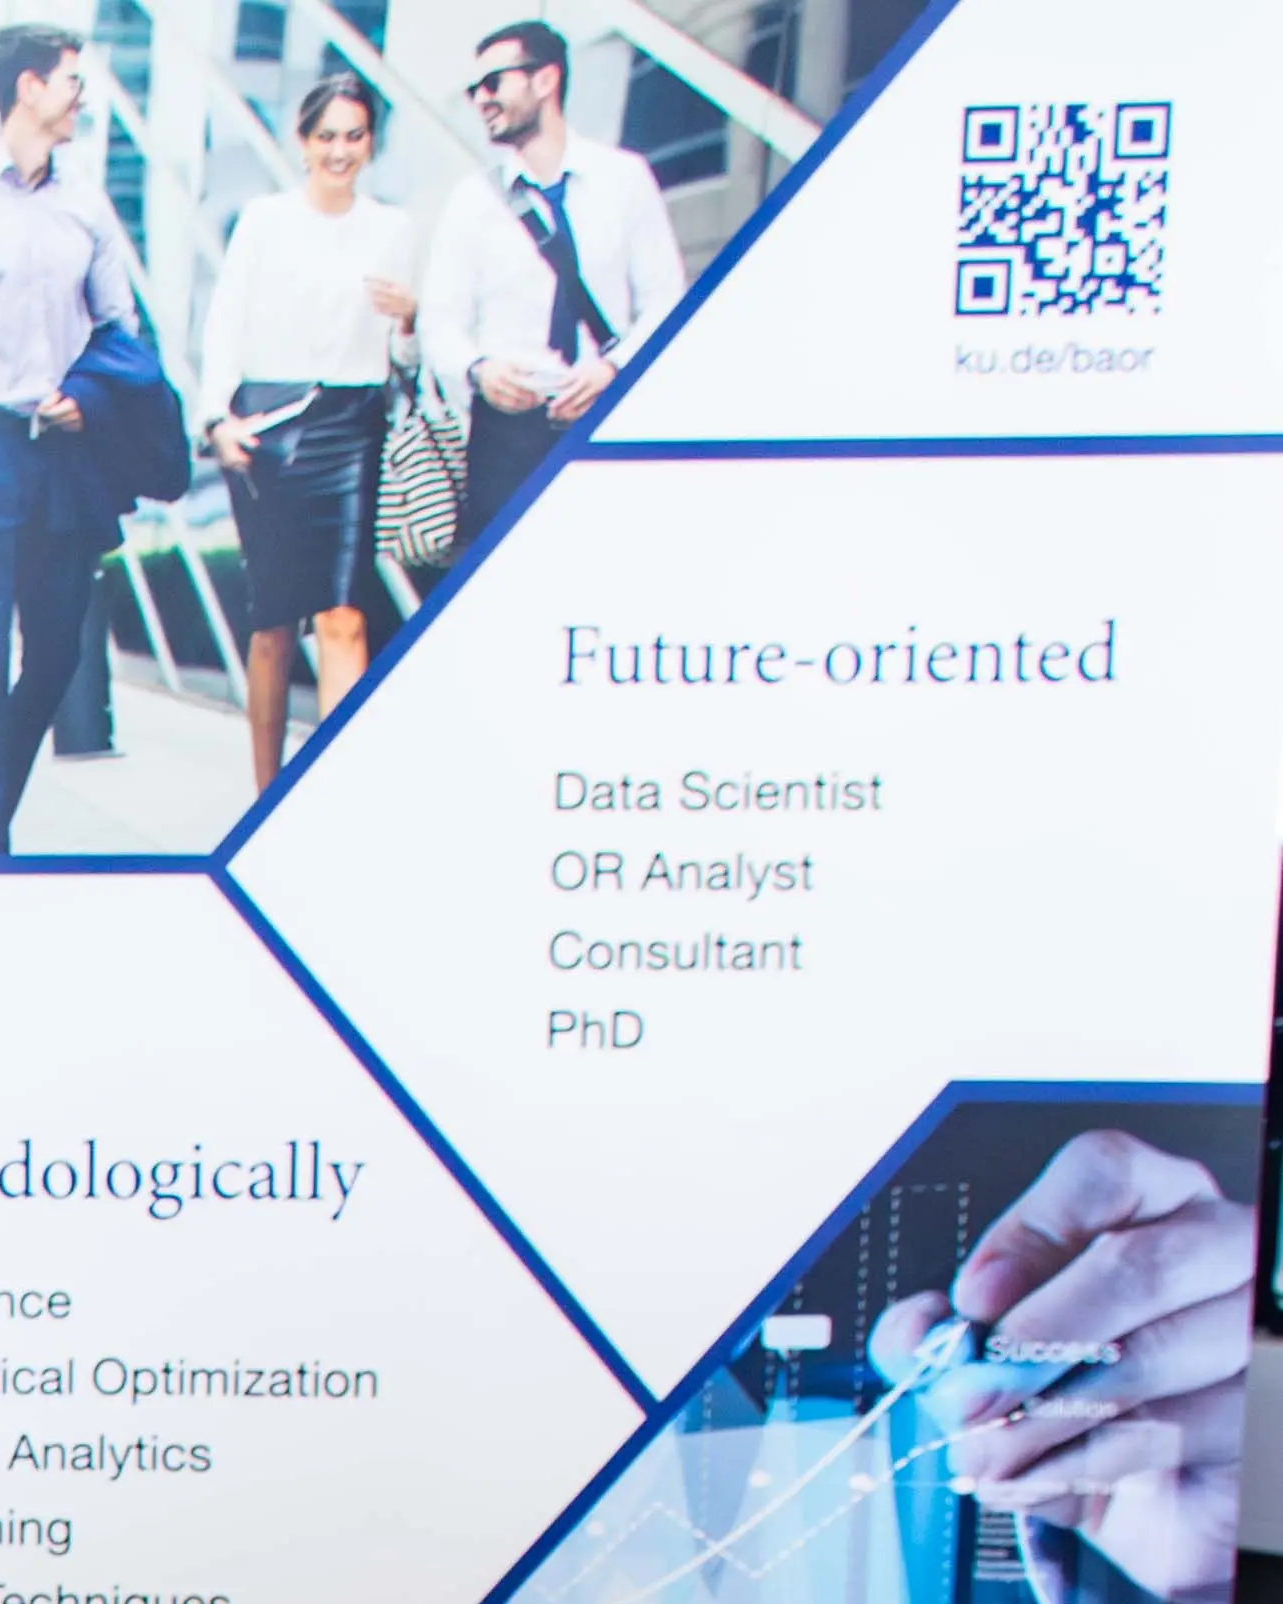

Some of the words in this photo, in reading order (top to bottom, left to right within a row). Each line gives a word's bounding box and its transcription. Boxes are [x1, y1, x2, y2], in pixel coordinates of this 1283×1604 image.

[954, 340, 1158, 376] ku.de/baor
[560, 617, 1120, 687] Future-oriented
[554, 769, 663, 811] Data
[679, 769, 884, 812] Scientist
[550, 850, 626, 892] OR
[640, 851, 815, 902] Analyst
[547, 929, 804, 972] Consultant
[546, 1008, 646, 1051] PhD
[91, 1357, 380, 1405] Optimization
[7, 1432, 214, 1482] Analytics
